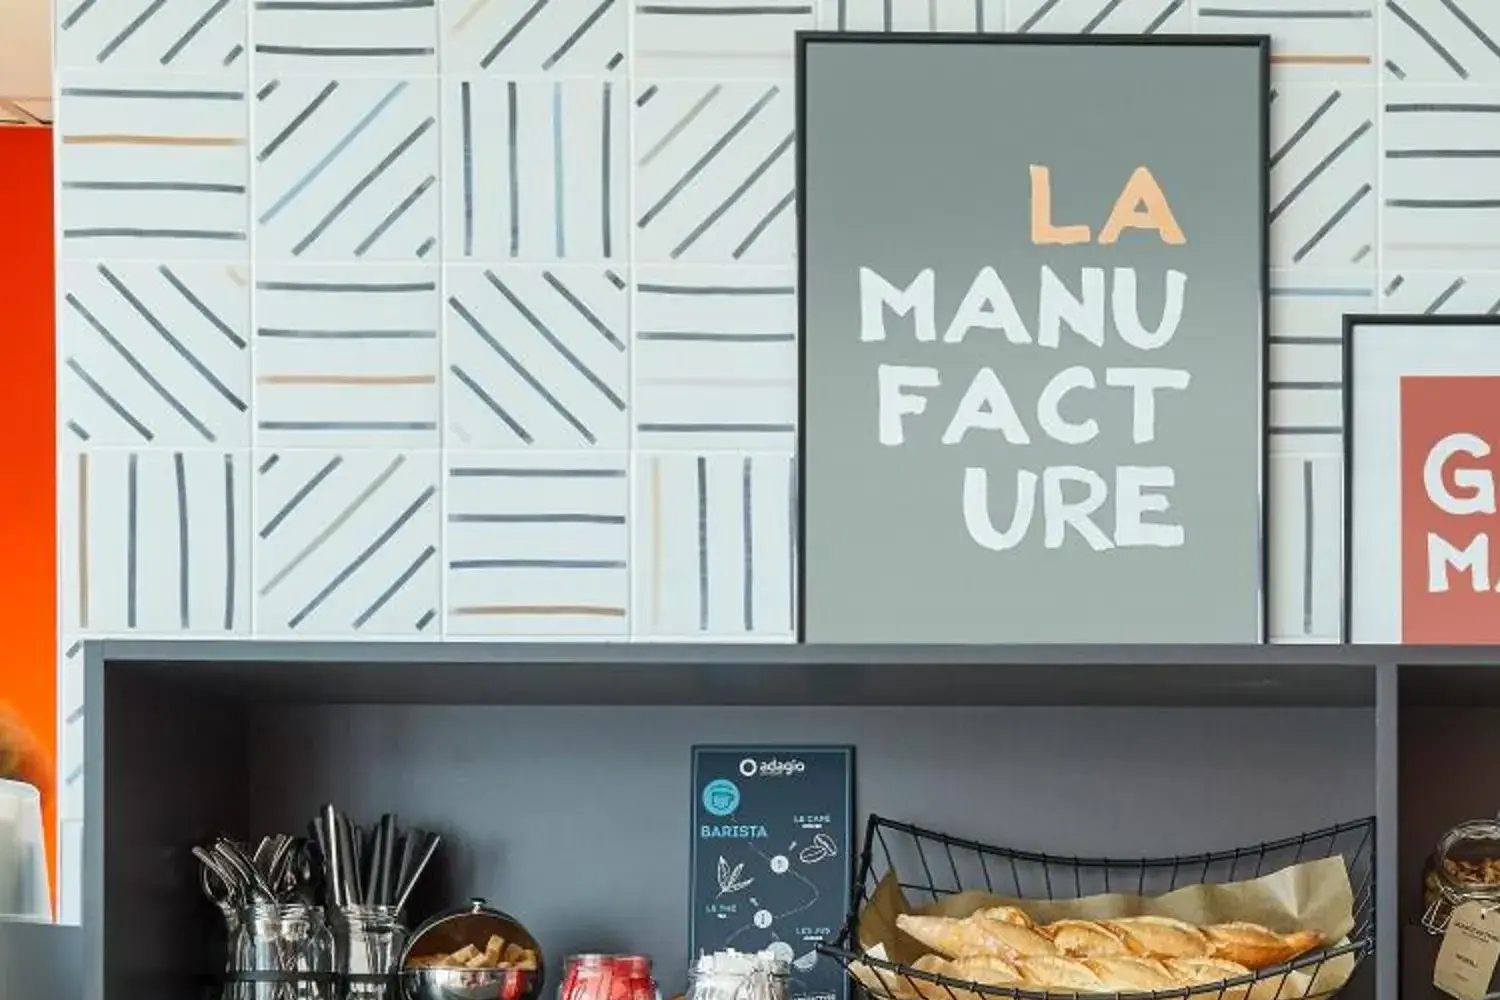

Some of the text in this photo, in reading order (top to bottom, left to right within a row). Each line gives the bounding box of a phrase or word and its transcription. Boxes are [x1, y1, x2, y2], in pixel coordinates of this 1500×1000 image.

[1029, 164, 1186, 244] LA
[859, 265, 1187, 349] MANU
[878, 364, 1190, 446] FACT
[963, 466, 1185, 551] URE
[760, 758, 805, 776] adagio
[701, 825, 768, 838] BARISTA
